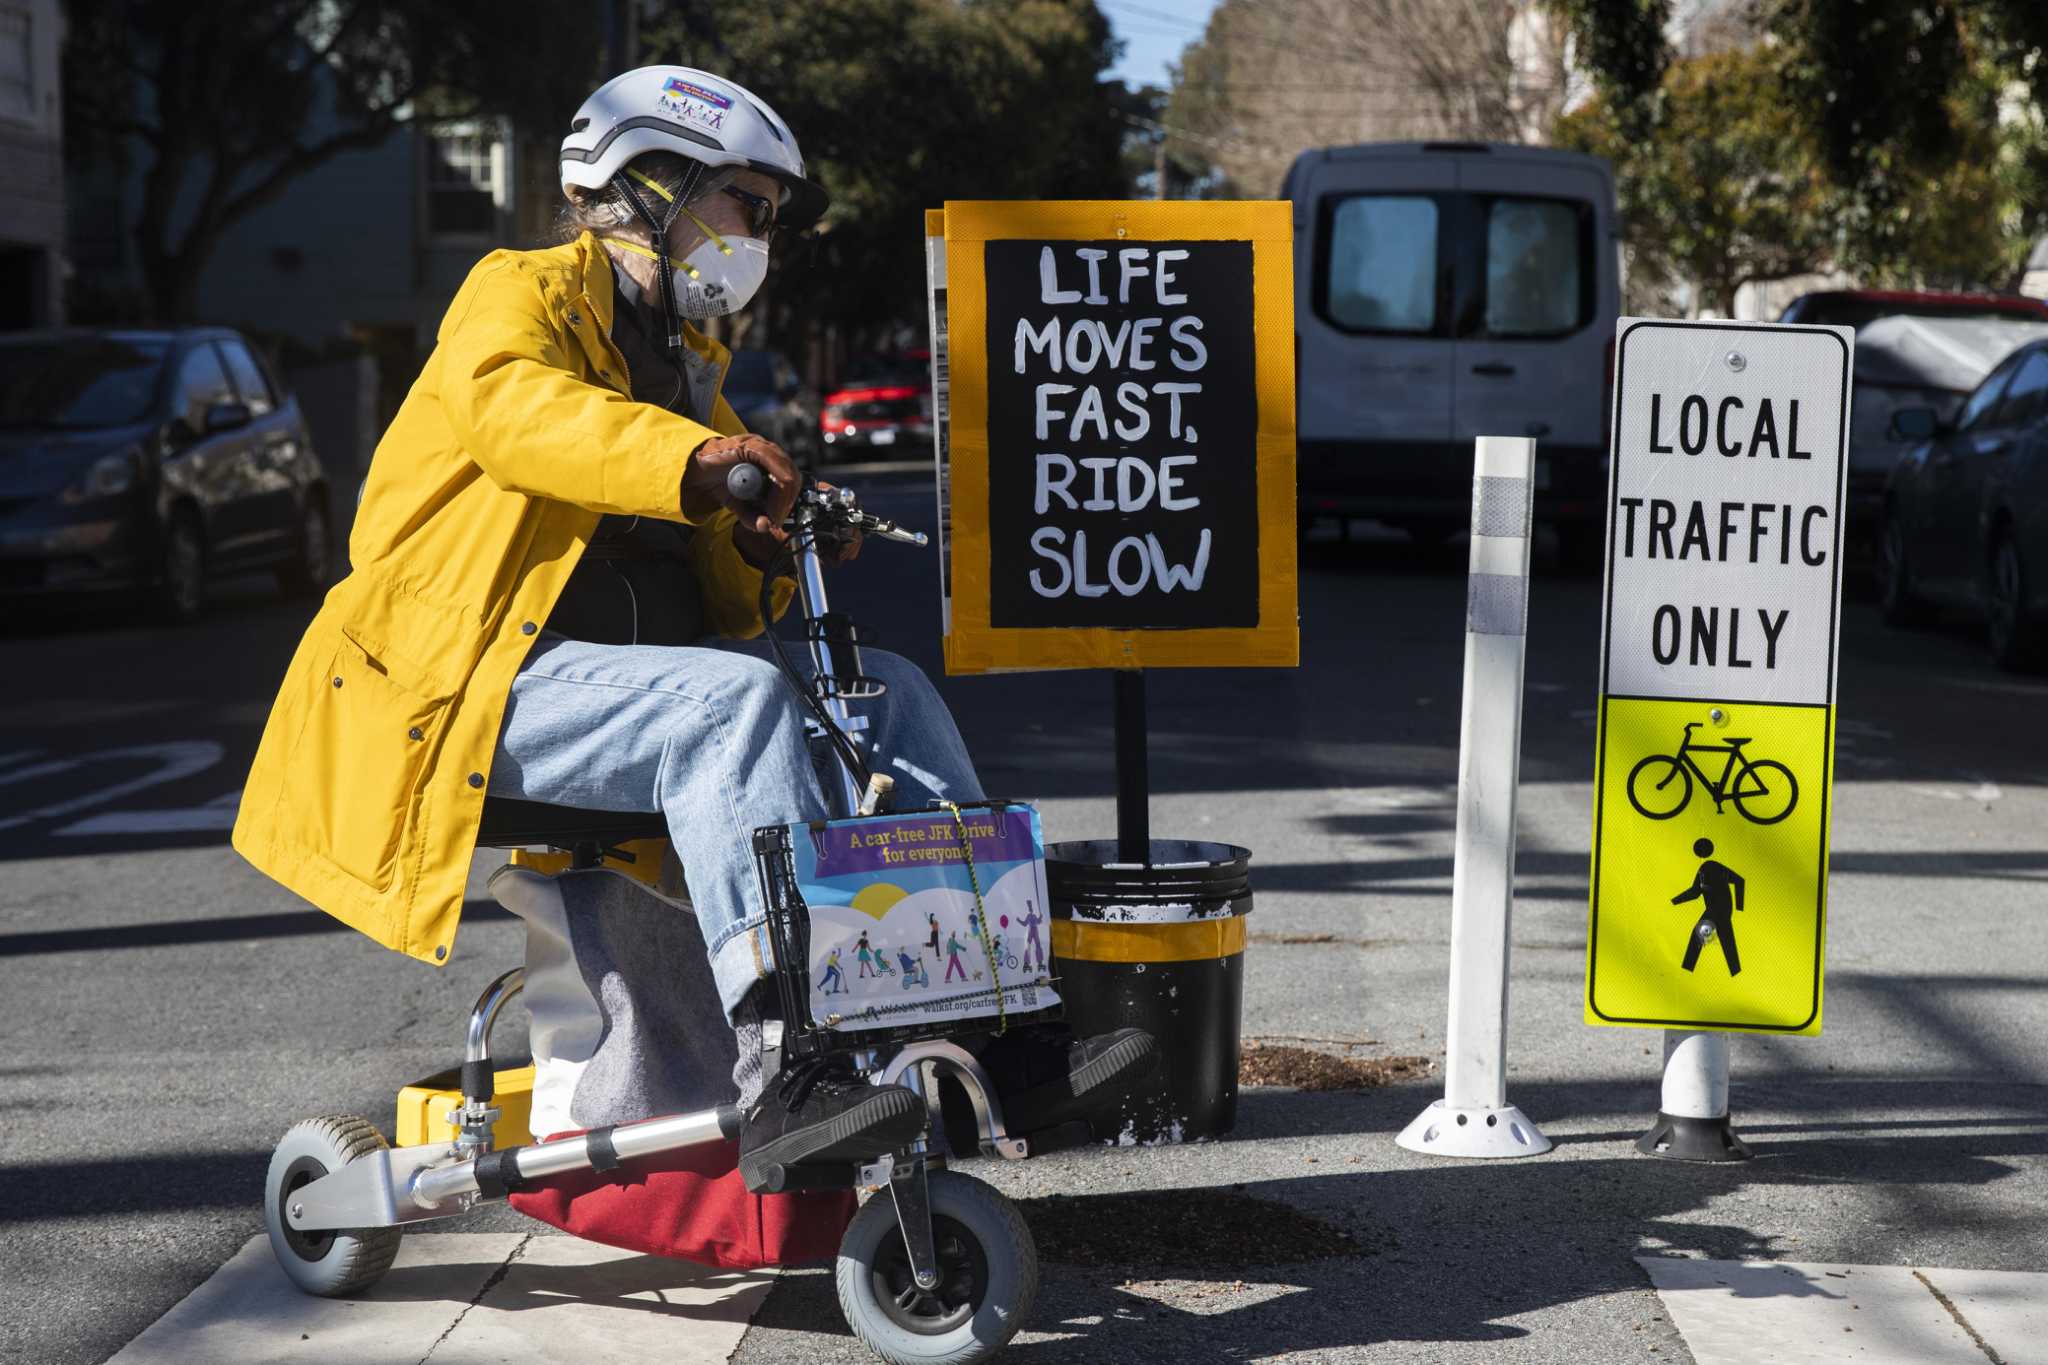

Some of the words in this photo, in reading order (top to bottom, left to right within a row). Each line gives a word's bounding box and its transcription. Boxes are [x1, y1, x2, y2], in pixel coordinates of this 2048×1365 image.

[1040, 246, 1190, 305] LIFE
[1014, 315, 1208, 374] MOVES
[1035, 382, 1202, 443] FAST.
[1649, 393, 1812, 460] LOCAL
[1034, 453, 1200, 515] RIDE
[1029, 526, 1212, 598] SLOW
[1620, 497, 1828, 567] TRAFFIC
[1652, 604, 1790, 669] ONLY
[850, 832, 863, 848] A
[865, 827, 926, 847] car-free
[928, 824, 954, 841] JFK
[882, 847, 905, 864] for
